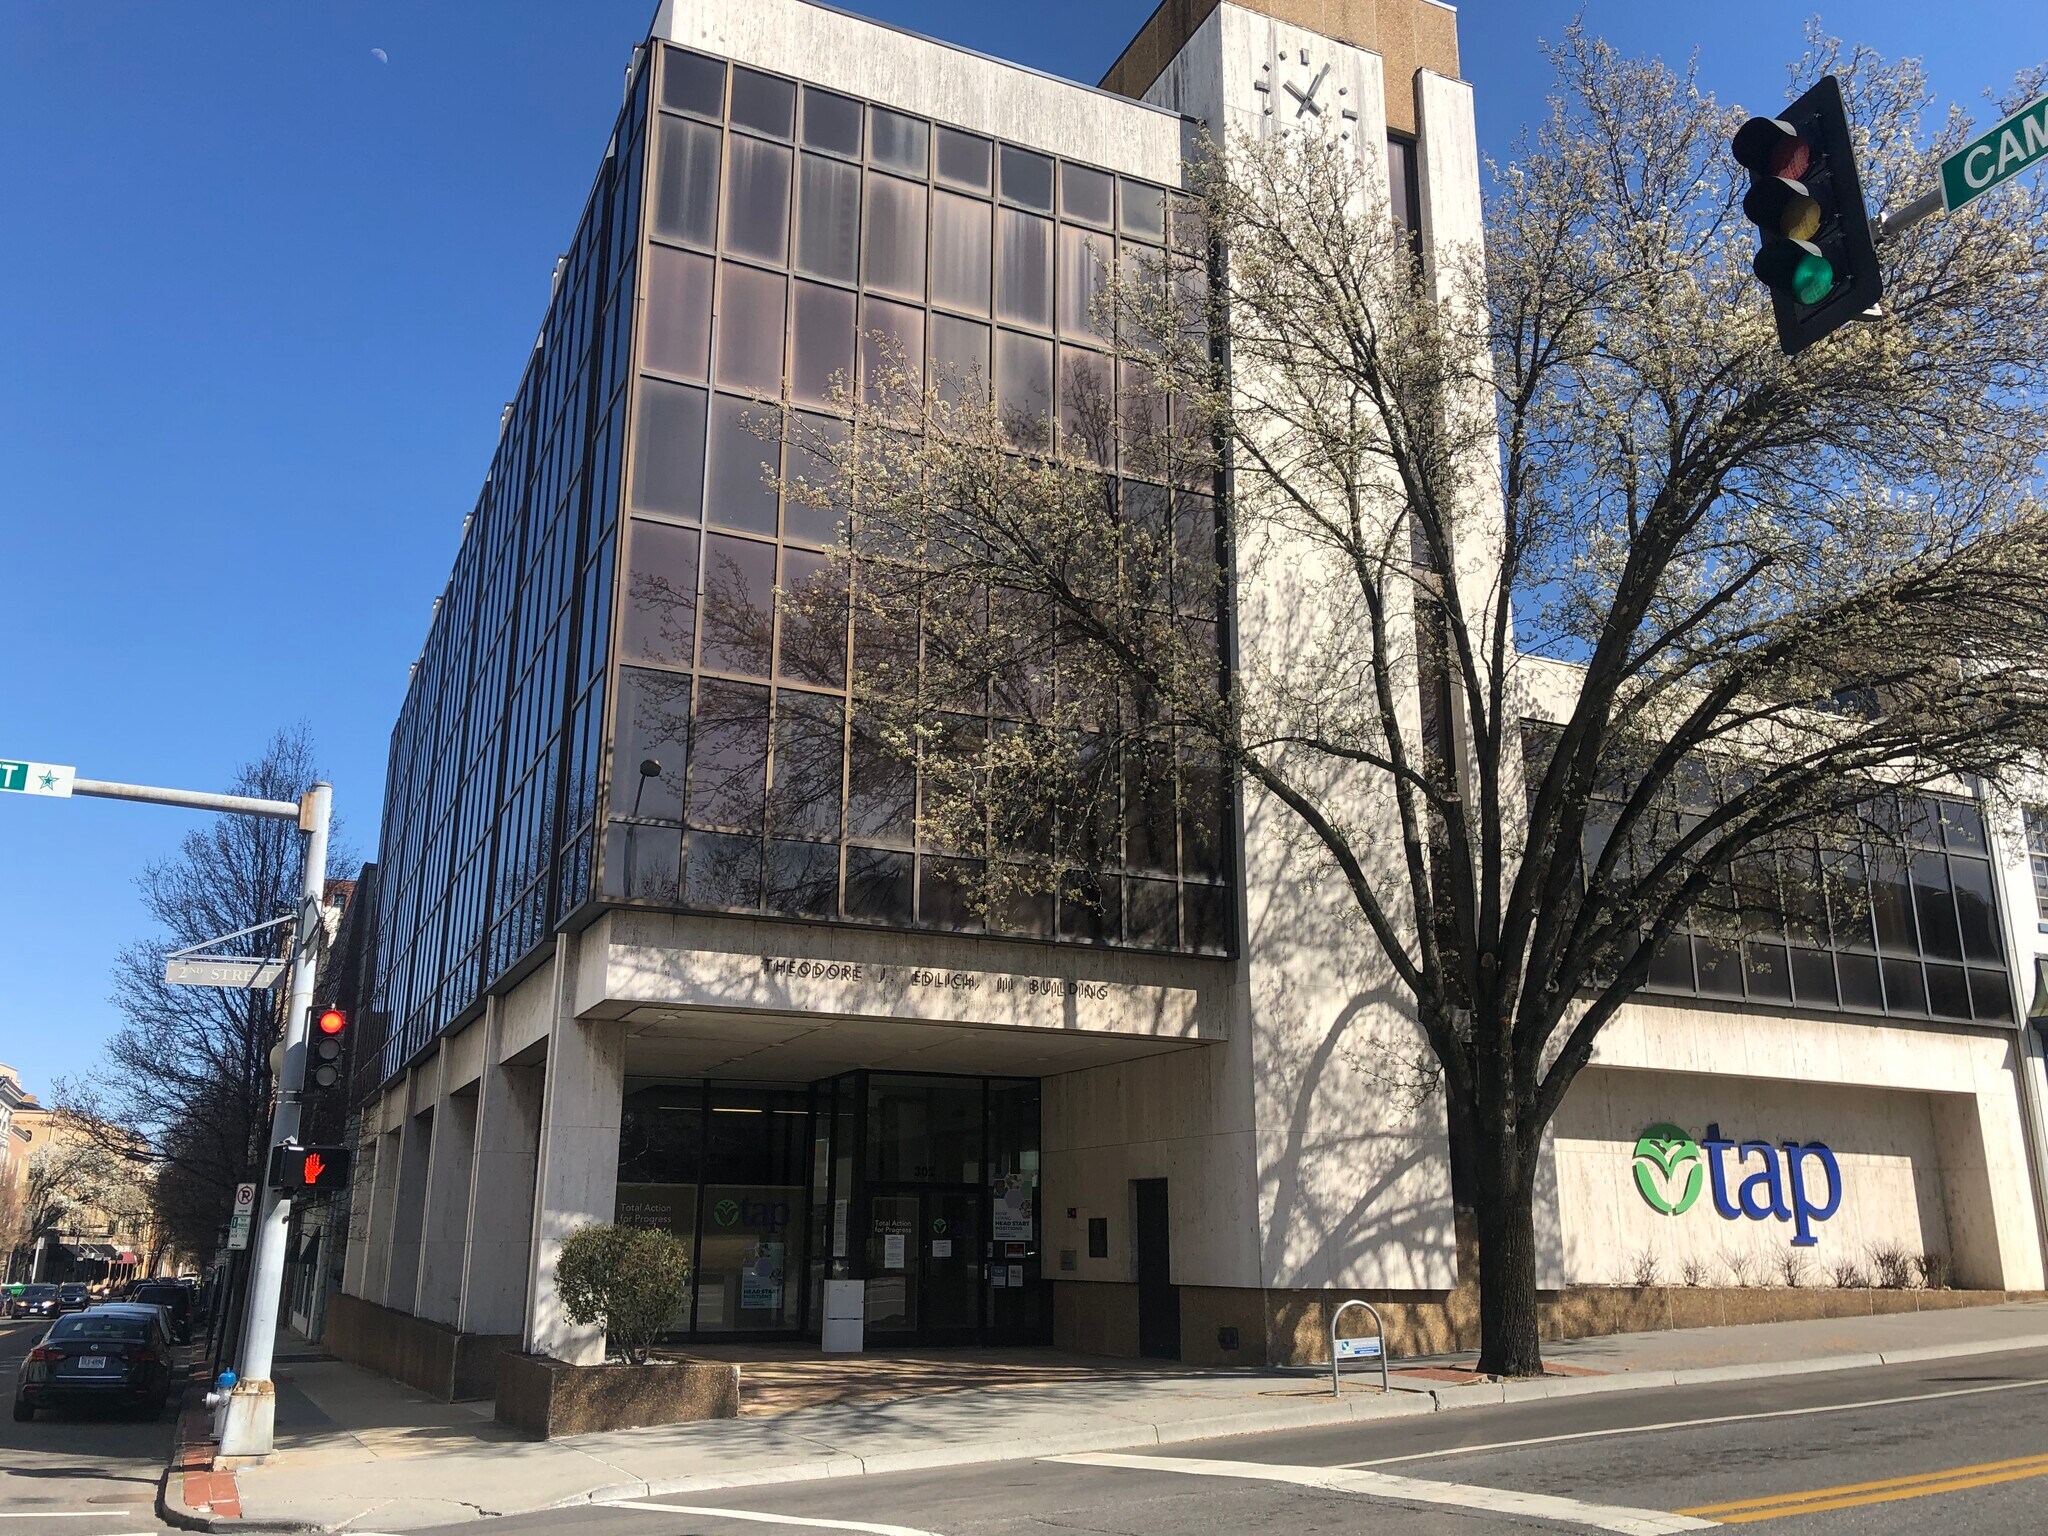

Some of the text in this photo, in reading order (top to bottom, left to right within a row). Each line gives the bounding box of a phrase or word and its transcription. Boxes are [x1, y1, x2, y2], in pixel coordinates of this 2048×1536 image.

[211, 968, 275, 983] STRET
[764, 958, 863, 982] THEODORE
[997, 977, 1014, 993] III
[1029, 979, 1109, 1000] BUILDING
[1702, 1122, 1842, 1247] tap
[620, 1203, 672, 1213] Total Action
[620, 1214, 672, 1225] for Progress
[742, 1199, 790, 1233] tap
[875, 1219, 891, 1227] Total
